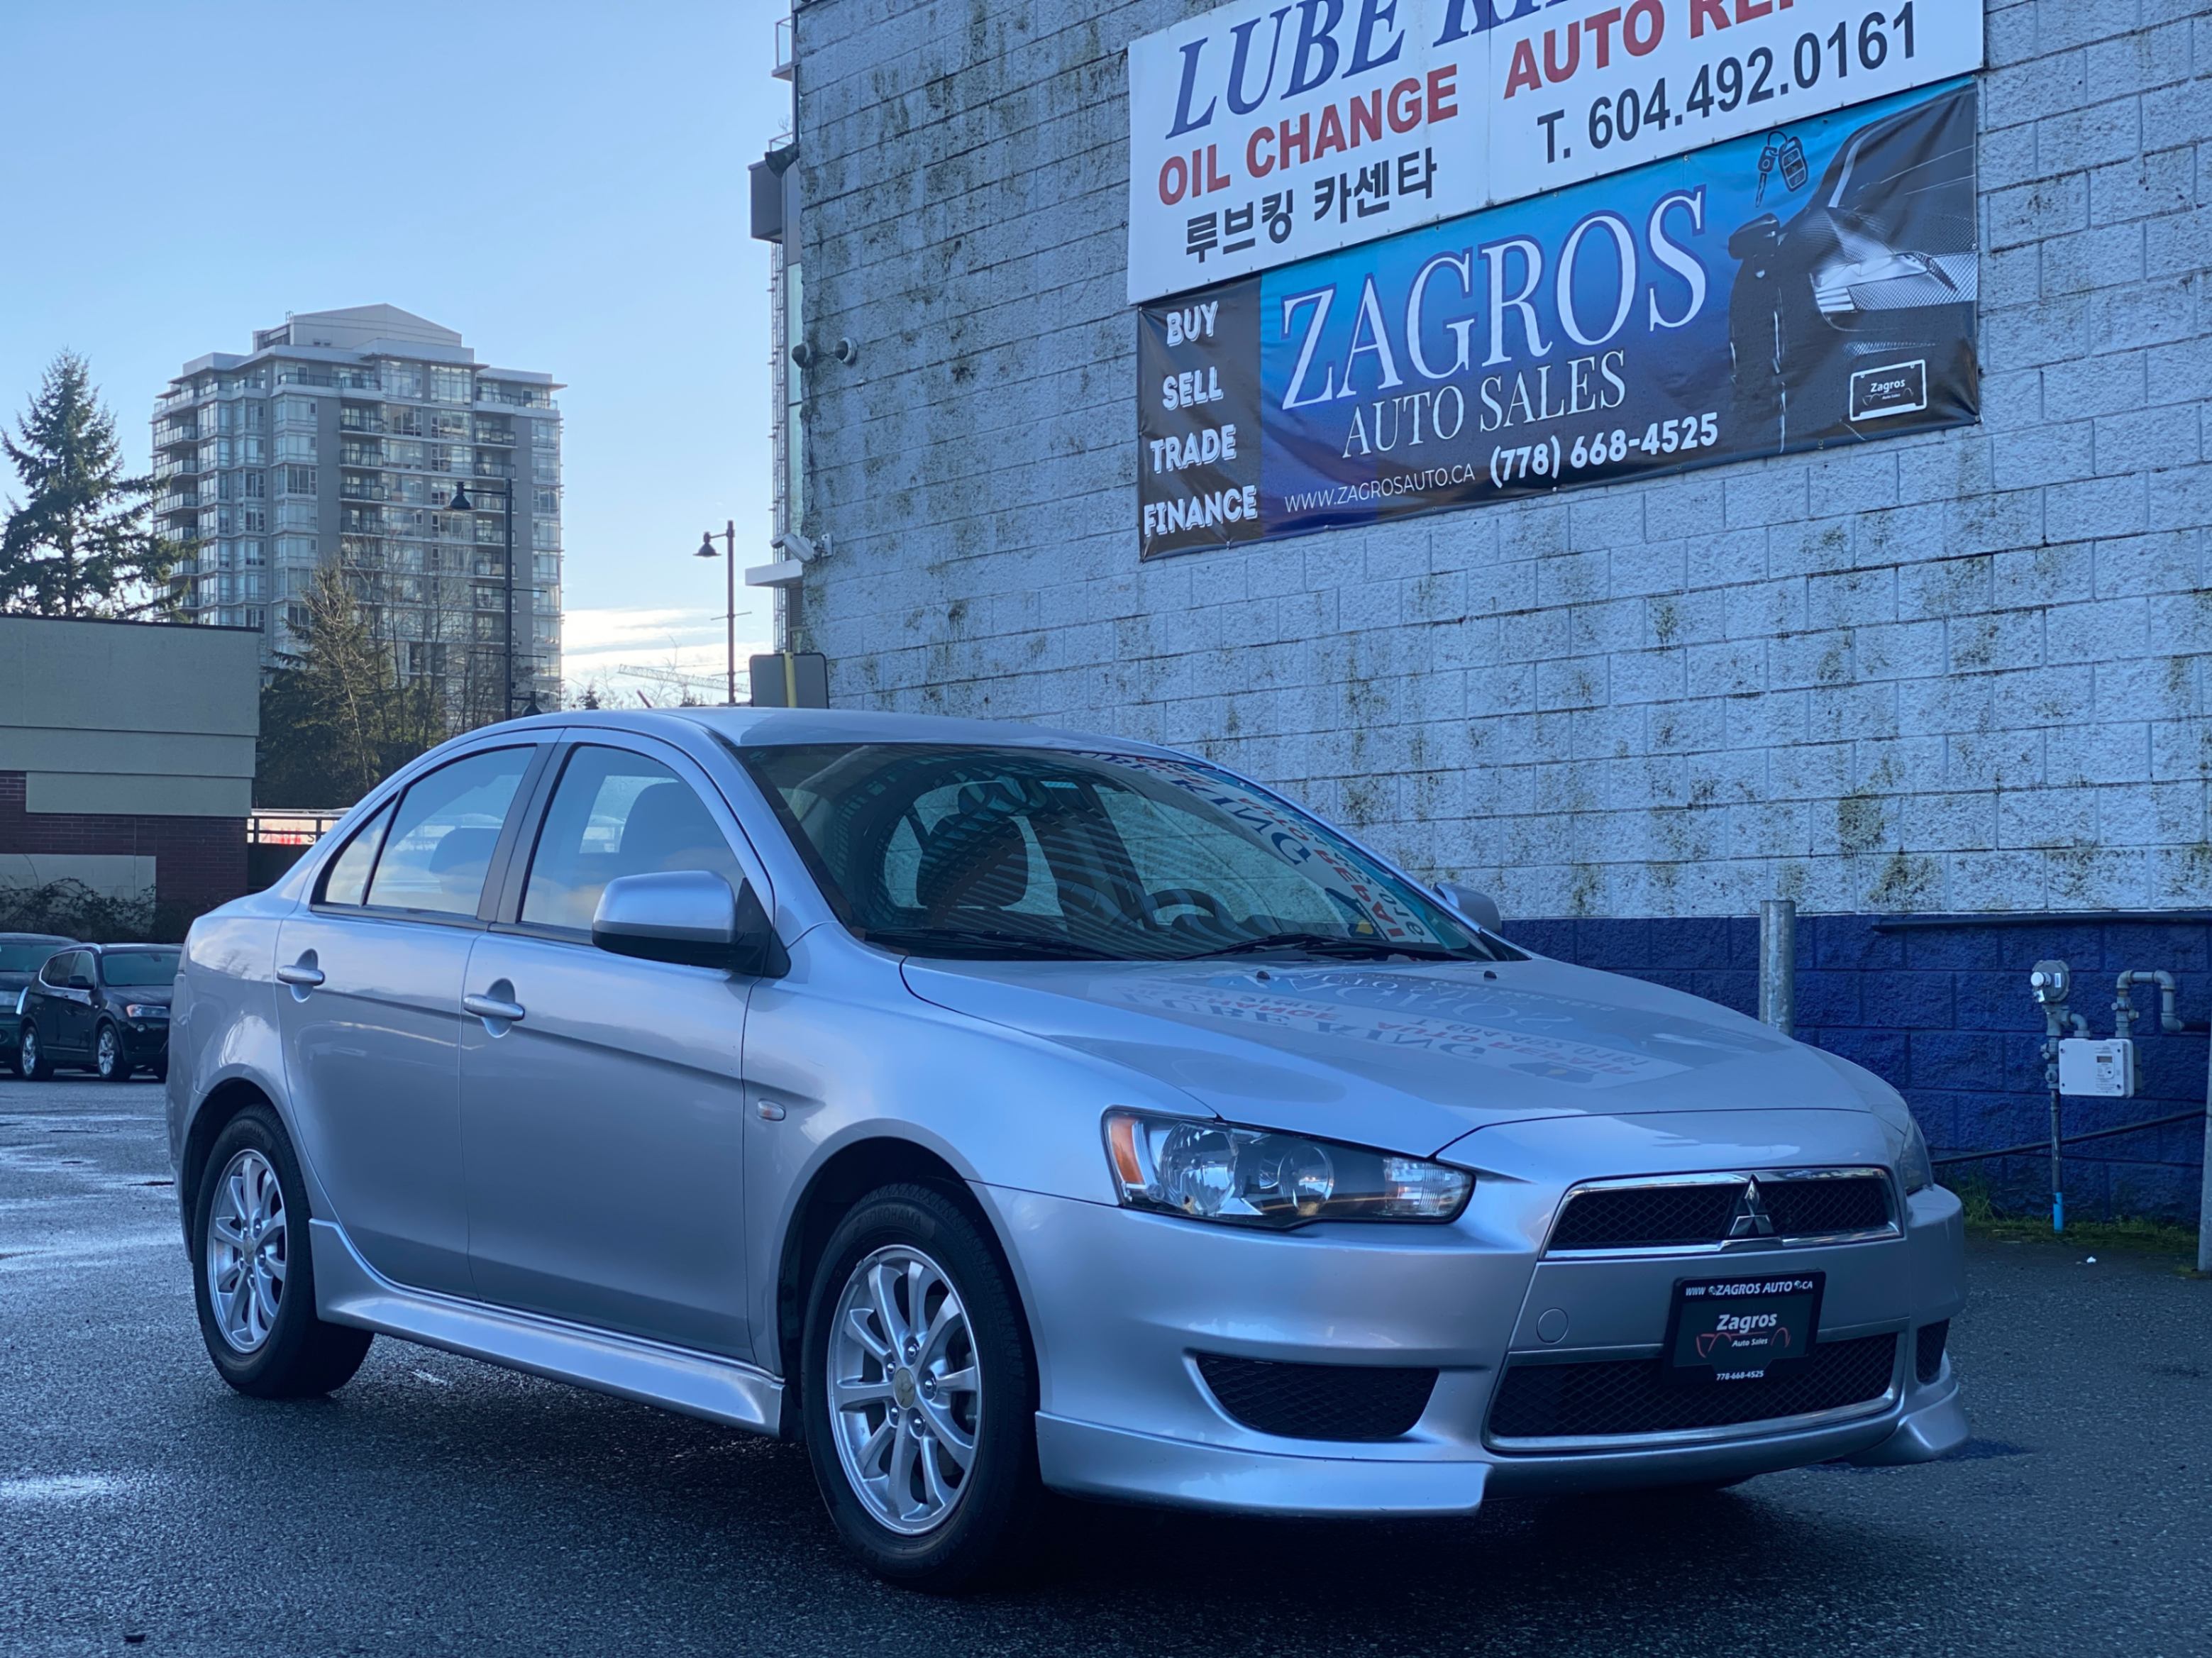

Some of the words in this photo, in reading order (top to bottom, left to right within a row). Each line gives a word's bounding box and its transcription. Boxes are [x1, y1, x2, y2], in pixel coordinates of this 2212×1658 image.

[1166, 0, 1405, 140] LUBE
[1503, 0, 1665, 100] AUTO
[1537, 110, 1571, 164] T.
[1588, 1, 1914, 149] 604.492.0161
[1158, 144, 1231, 206] OIL
[1246, 64, 1458, 178] CHANGE
[1186, 189, 1293, 263] 루브킹
[1315, 147, 1437, 224] 카센타
[1166, 301, 1220, 346] BUY
[1281, 186, 1708, 411] ZAGROS
[1162, 367, 1224, 411] SELL
[1342, 385, 1464, 459] AUTO
[1479, 350, 1626, 432] SALES
[1870, 379, 1906, 393] Zagros
[1150, 424, 1237, 473] TRADE
[1285, 463, 1476, 512] WWW.ZAGROSAUTO.CA
[1491, 436, 1561, 488] (778)
[1571, 412, 1719, 469] 668-4525
[1144, 485, 1259, 537] FINANCE
[1715, 1283, 1761, 1296] ZAGROS
[1762, 1281, 1793, 1293] AUTO
[1716, 1313, 1778, 1334] Zagros
[1716, 1370, 1764, 1381] 778-668-4525
